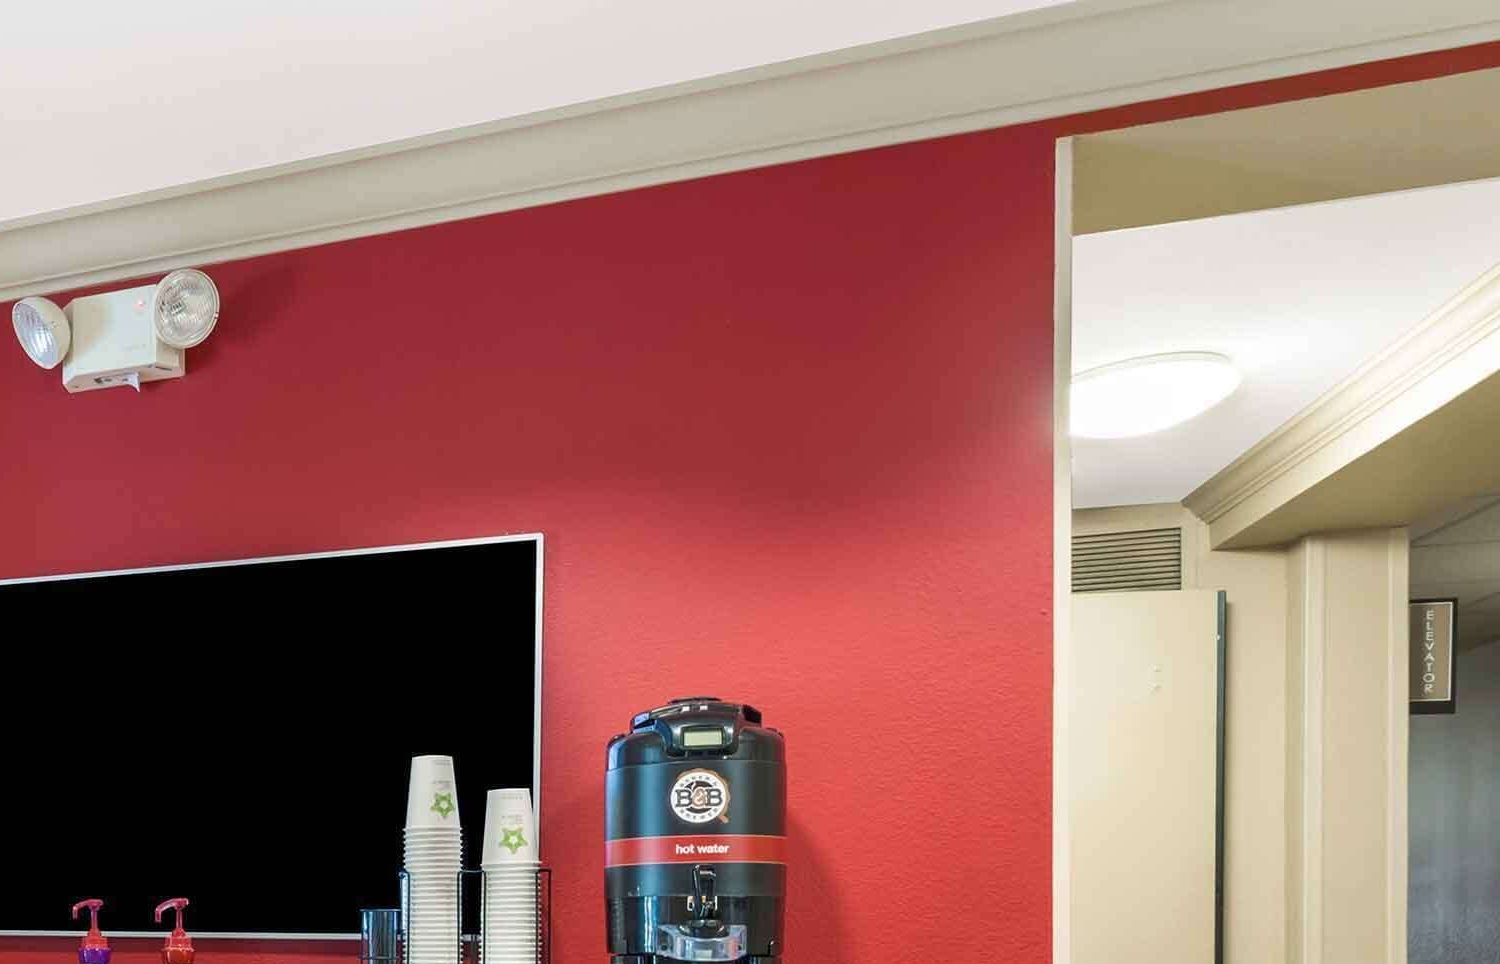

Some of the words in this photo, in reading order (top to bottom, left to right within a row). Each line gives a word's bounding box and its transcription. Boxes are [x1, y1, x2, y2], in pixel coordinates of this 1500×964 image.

[1422, 609, 1436, 695] ELEVATOR
[675, 786, 723, 808] B&B
[675, 843, 695, 854] hot
[697, 844, 730, 854] water
